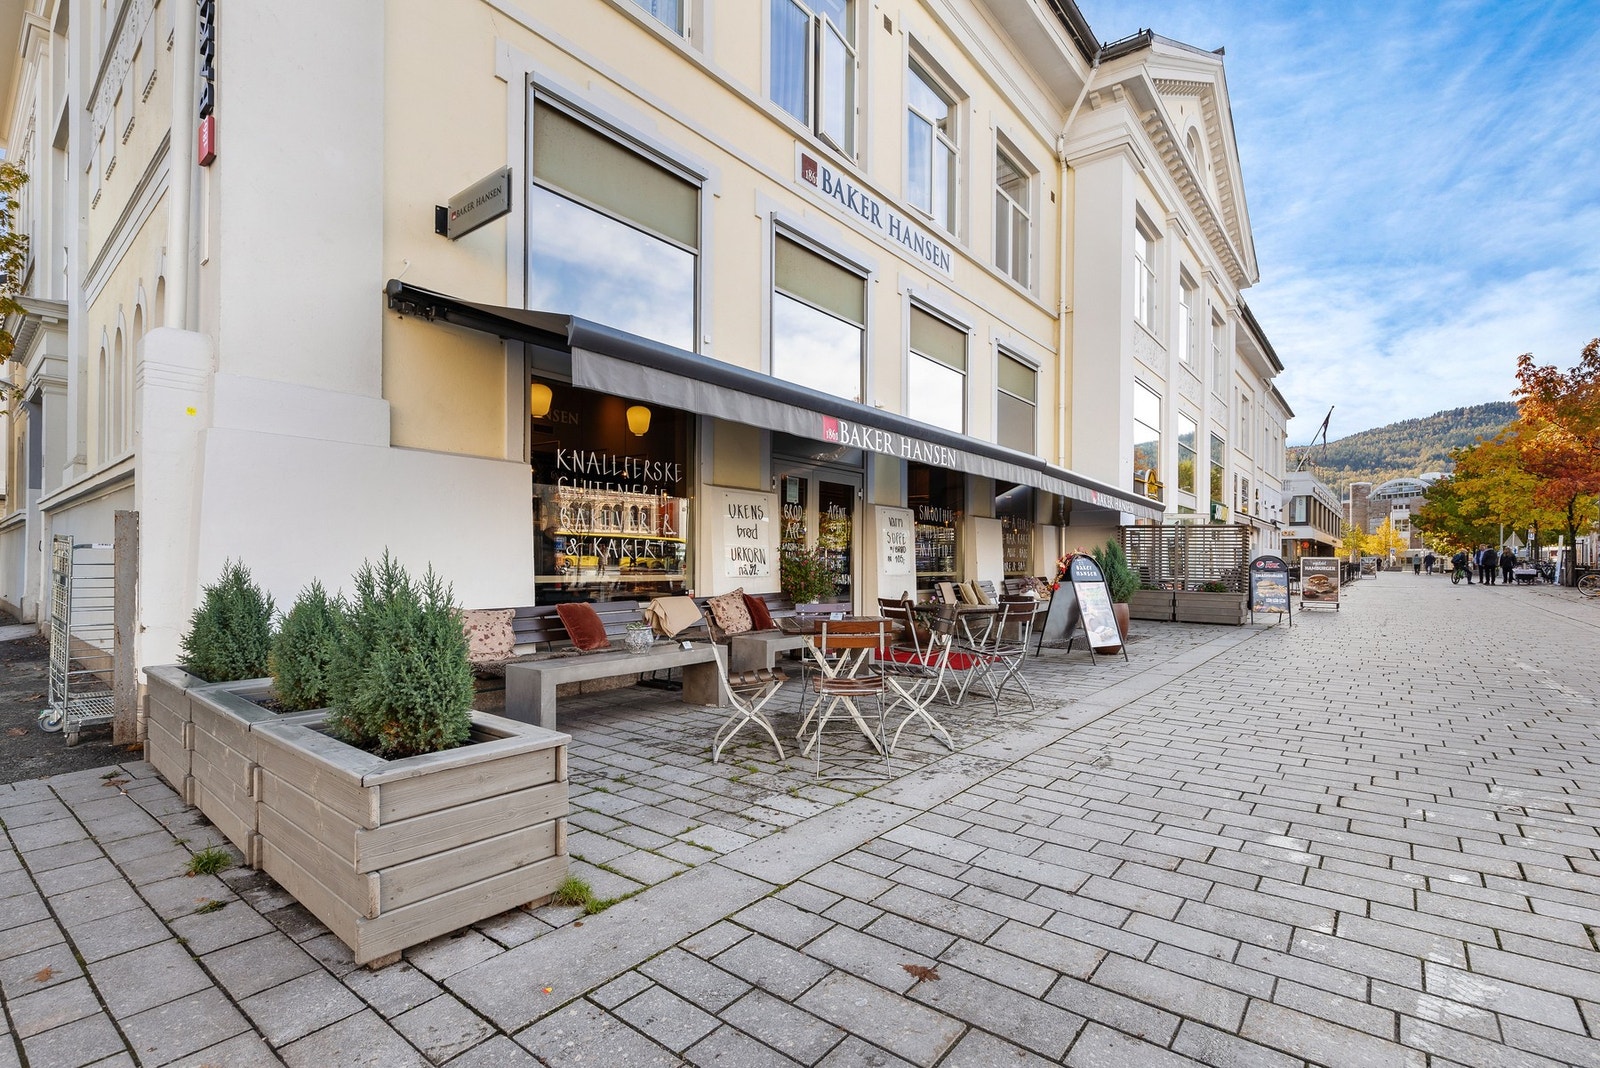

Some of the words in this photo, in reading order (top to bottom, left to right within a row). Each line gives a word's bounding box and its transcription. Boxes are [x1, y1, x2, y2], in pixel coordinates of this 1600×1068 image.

[456, 202, 475, 218] BAKER
[476, 185, 502, 207] HANSEN
[821, 166, 883, 230] BAKER
[888, 213, 950, 273] HANSEN
[839, 421, 895, 455] BAKER
[900, 437, 956, 468] HANSEN
[557, 448, 682, 483] KNALLFERSKE
[728, 504, 764, 520] UKENS
[730, 547, 766, 565] URKORN
